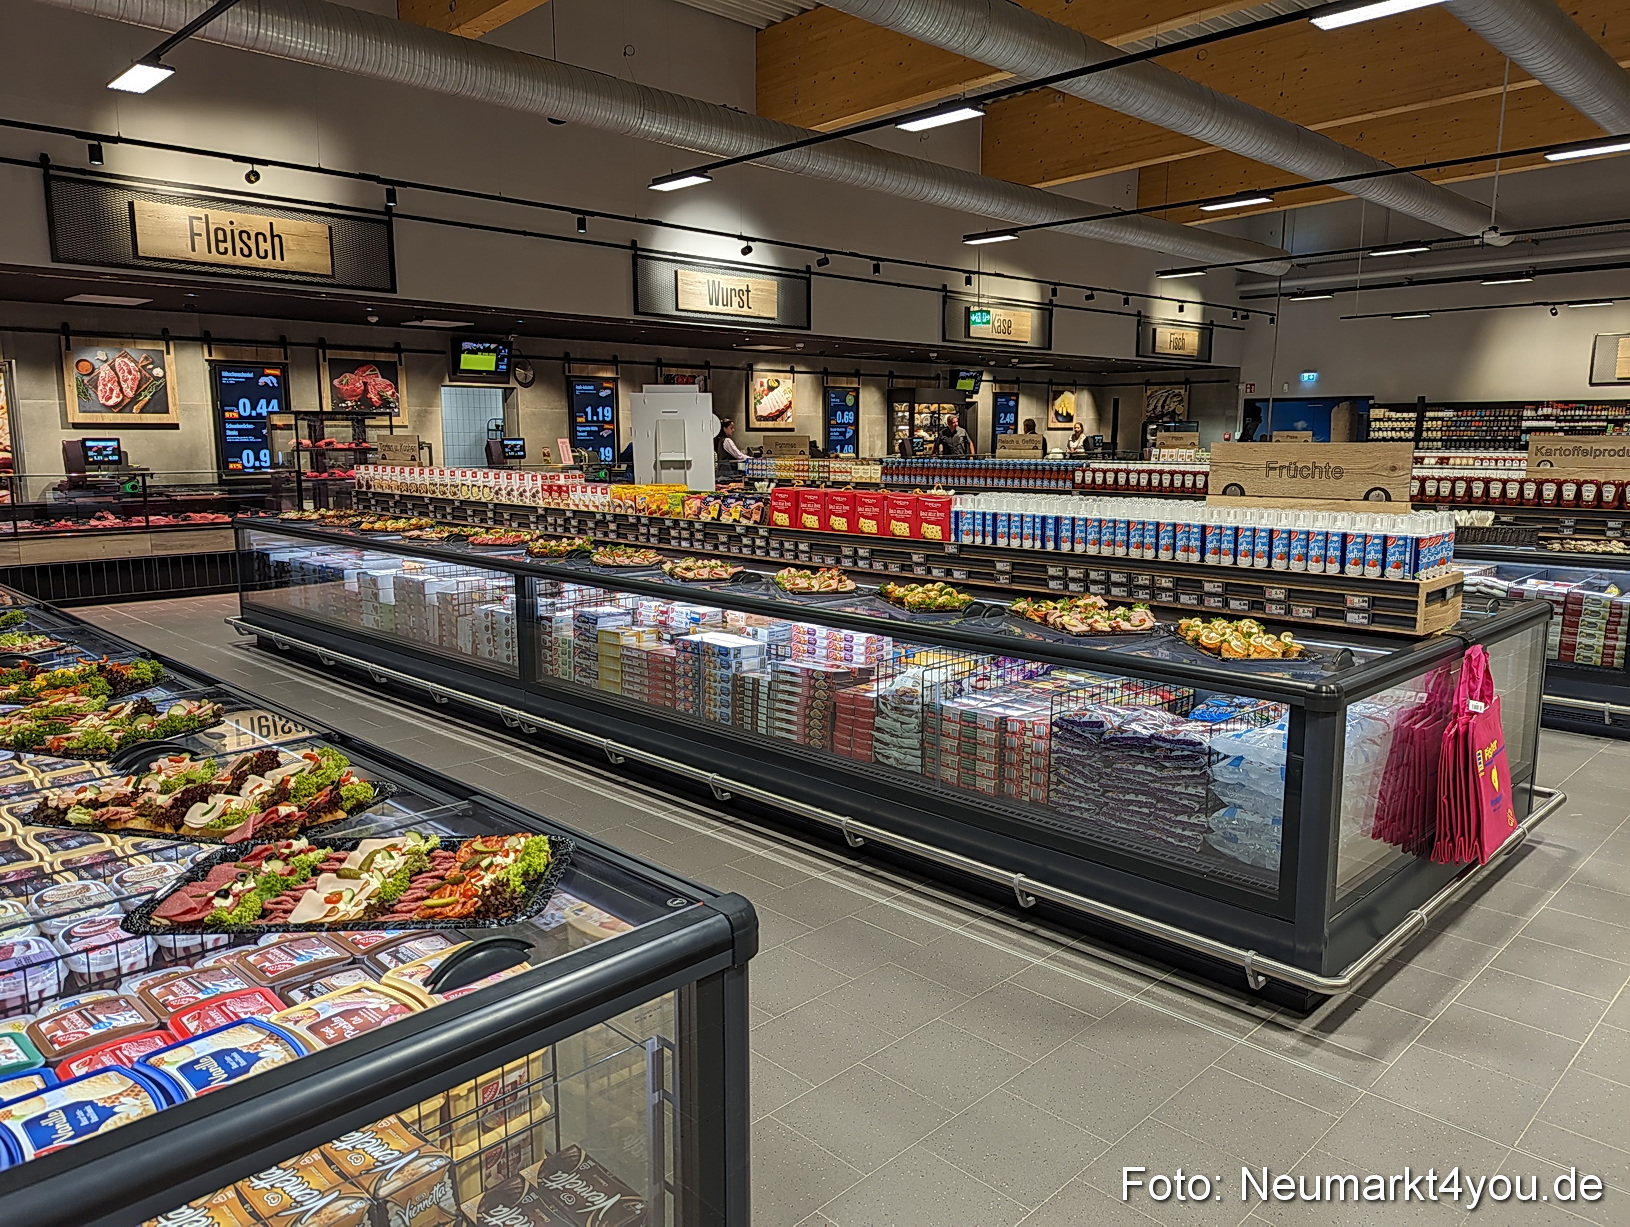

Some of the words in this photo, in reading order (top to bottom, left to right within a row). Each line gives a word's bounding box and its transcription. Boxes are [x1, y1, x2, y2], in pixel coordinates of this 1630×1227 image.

[187, 213, 285, 262] Fleisch
[706, 279, 752, 310] Wurst
[990, 313, 1013, 336] Käse
[1168, 332, 1186, 352] Fisch
[238, 397, 280, 417] 0.44
[586, 405, 613, 421] 1.19
[836, 410, 855, 424] 0.69
[999, 412, 1015, 424] 2.49
[1264, 460, 1345, 481] Früchte
[193, 1055, 229, 1085] Vanille
[39, 1109, 76, 1145] Vanille
[330, 1129, 420, 1181] Viennetta
[249, 1165, 341, 1225] Viennetta
[396, 1181, 447, 1227] Viennetta
[541, 1170, 622, 1221] Viennetta
